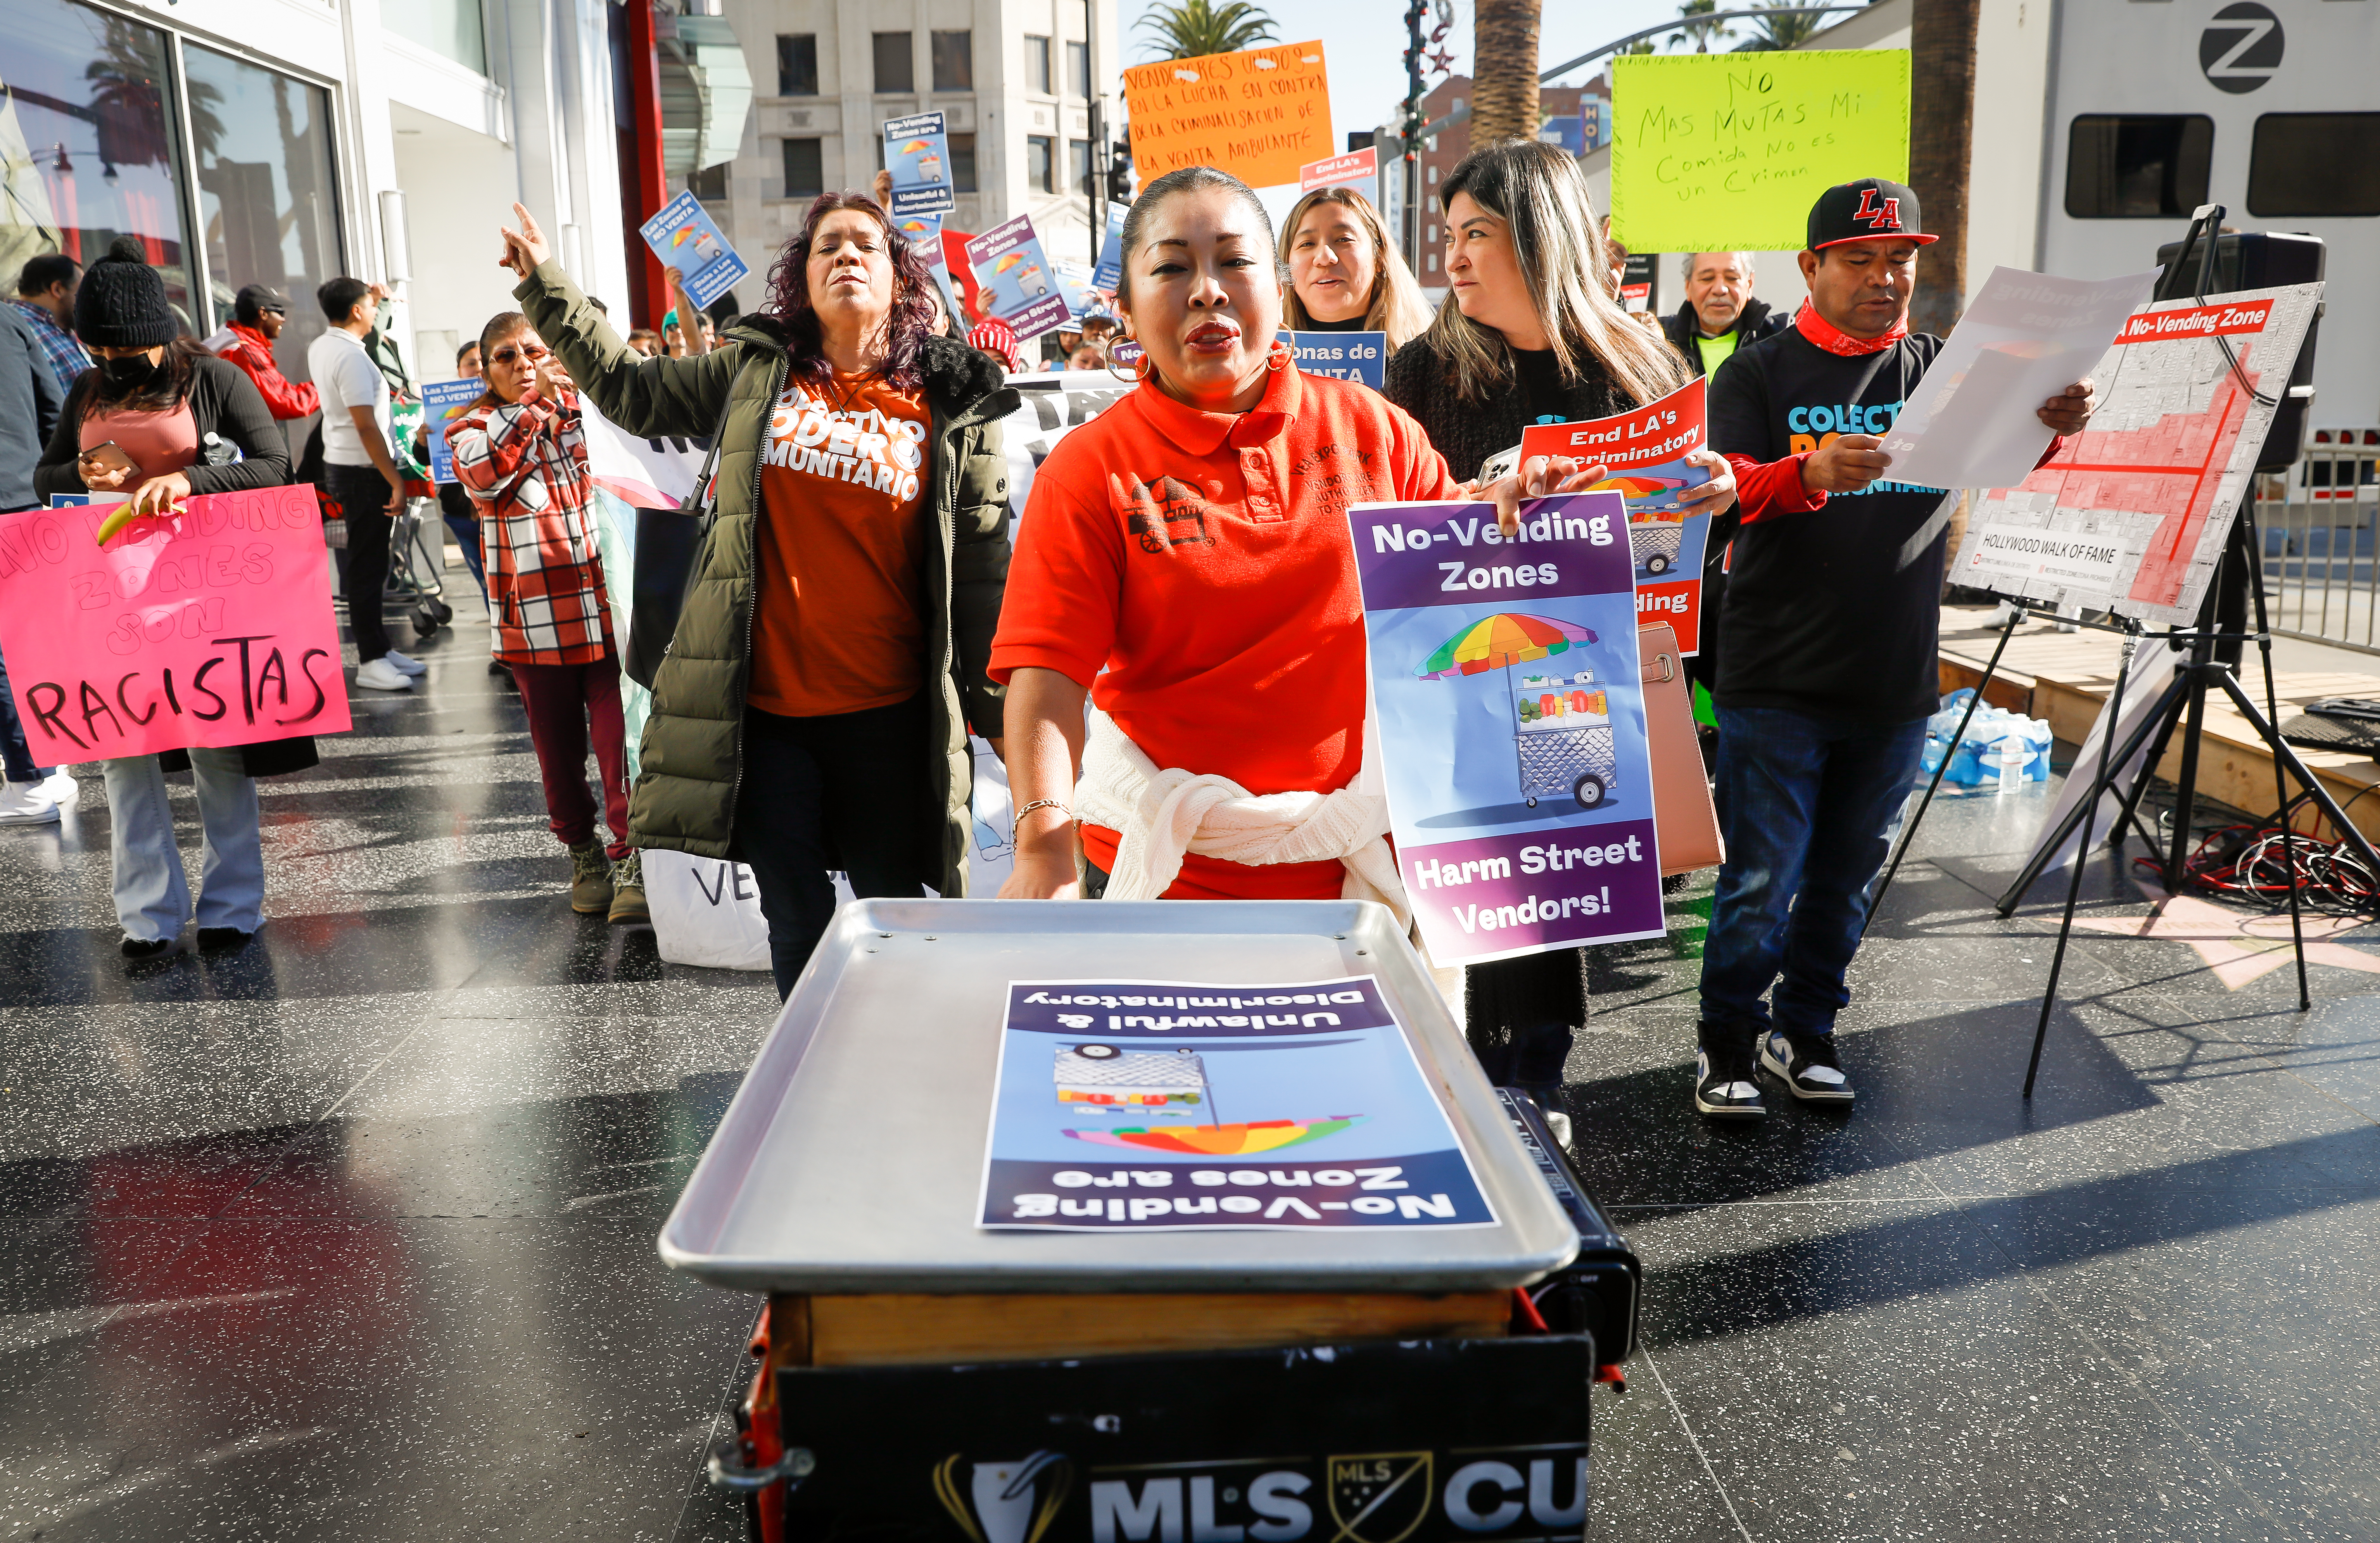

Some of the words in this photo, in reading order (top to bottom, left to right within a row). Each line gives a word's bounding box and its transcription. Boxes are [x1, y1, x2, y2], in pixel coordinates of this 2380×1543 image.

[1126, 56, 1233, 90] VENDEDRES
[1728, 69, 1773, 107] NO
[1130, 98, 1149, 115] EN
[1152, 93, 1174, 111] LA
[1181, 84, 1230, 104] LUCHA
[1242, 81, 1263, 99] EN
[1269, 73, 1327, 96] CONTRA
[1134, 123, 1148, 141] DE
[1150, 122, 1165, 138] LA
[1171, 105, 1284, 135] CRIMINALISACION
[1298, 100, 1316, 119] DE
[1638, 105, 1693, 148] MAS
[1714, 100, 1805, 142] MUTAS
[1140, 154, 1160, 171] LA
[1166, 146, 1216, 167] VENTA
[1228, 126, 1313, 161] AMBULANTE
[1316, 161, 1335, 174] End
[1337, 157, 1360, 168] LA's
[1656, 145, 1747, 183] Comida
[1304, 164, 1373, 189] Discriminatory
[652, 227, 667, 242] NO
[664, 206, 695, 230] VENTA
[1853, 188, 1902, 228] LA
[970, 218, 1029, 254] No-Vending
[986, 237, 1018, 257] Zones
[1009, 313, 1030, 327] arm
[1028, 296, 1062, 318] Street
[1014, 312, 1059, 338] Vendors!
[2128, 311, 2221, 336] No-Vending
[2219, 308, 2266, 328] Zone
[1280, 342, 1344, 360] onas
[1349, 343, 1377, 360] de
[429, 396, 446, 404] NO
[1533, 424, 1700, 465] criminatory
[1570, 426, 1621, 446] End
[1628, 410, 1677, 439] LA's
[763, 438, 919, 502] MUNITARIO
[1316, 505, 1332, 516] TO
[0, 517, 69, 579] NO
[1982, 533, 2040, 553] HOLLYWOOD
[2040, 540, 2070, 558] WALK
[2069, 544, 2086, 559] OF
[2084, 545, 2117, 564] FAME
[69, 543, 274, 610] ZONES
[1439, 562, 1559, 593] Zones
[106, 597, 225, 656] SON
[26, 635, 328, 749] RACISTAS
[1414, 855, 1511, 890] Harm
[1519, 834, 1643, 875] Street
[1452, 886, 1612, 935] Vendors!
[1024, 990, 1366, 1008] Discriminatory
[1057, 1014, 1095, 1029] &
[1110, 1012, 1342, 1030] Unlawful
[1052, 1169, 1174, 1189] are
[1190, 1166, 1410, 1191] Zones
[1014, 1194, 1457, 1222] No-Vending
[1337, 1460, 1392, 1484] MLS
[1090, 1470, 1314, 1543] MLS
